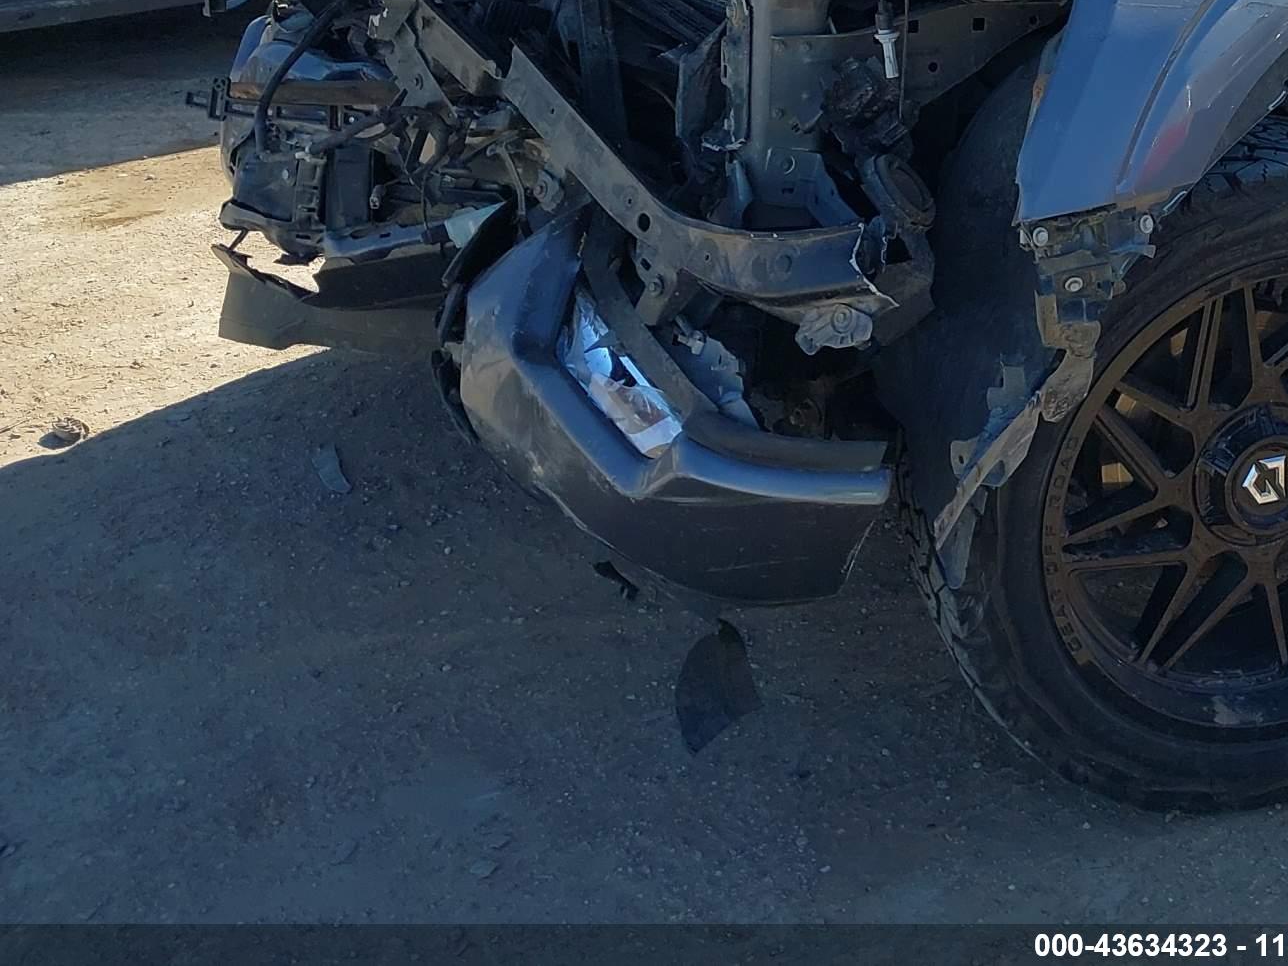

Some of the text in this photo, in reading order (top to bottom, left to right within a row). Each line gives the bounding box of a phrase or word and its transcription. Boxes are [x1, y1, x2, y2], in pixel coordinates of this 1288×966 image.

[1044, 436, 1084, 653] GEAR OFF ROAD
